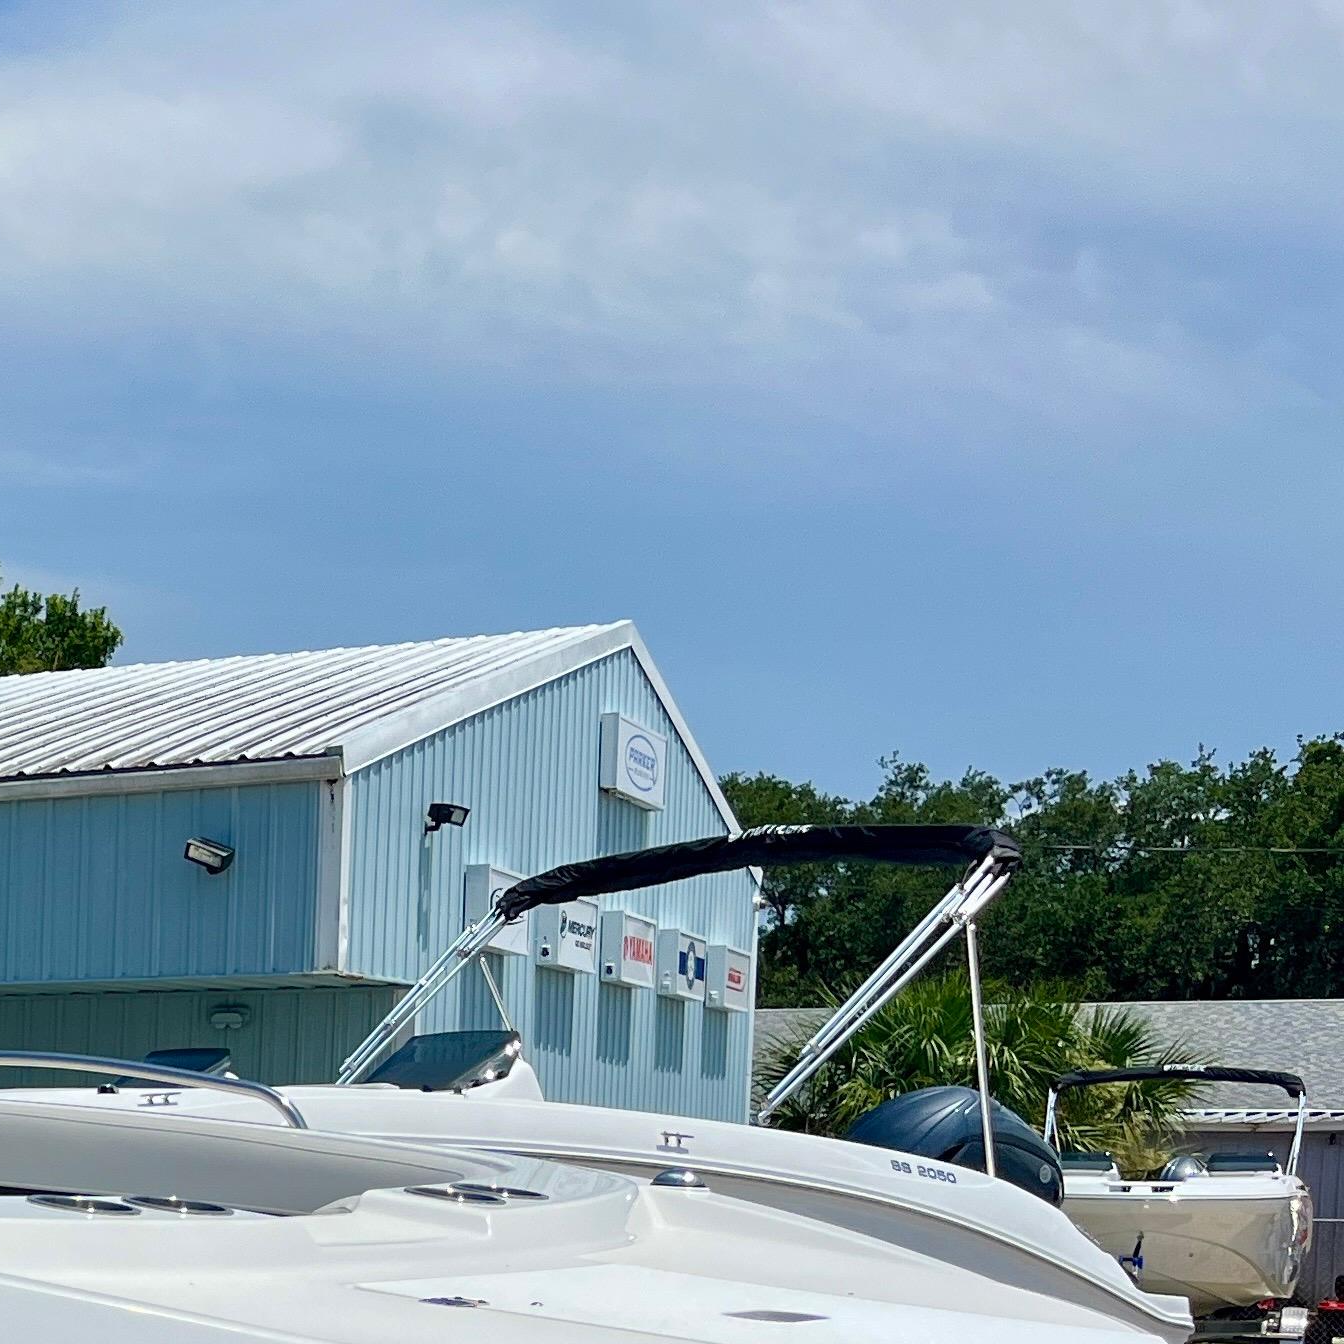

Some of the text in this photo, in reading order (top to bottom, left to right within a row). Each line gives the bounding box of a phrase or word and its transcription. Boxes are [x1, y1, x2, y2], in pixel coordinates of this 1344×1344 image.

[568, 920, 596, 940] MERCURY
[629, 936, 653, 966] YAMAHA
[891, 1160, 957, 1184] SS 2050
